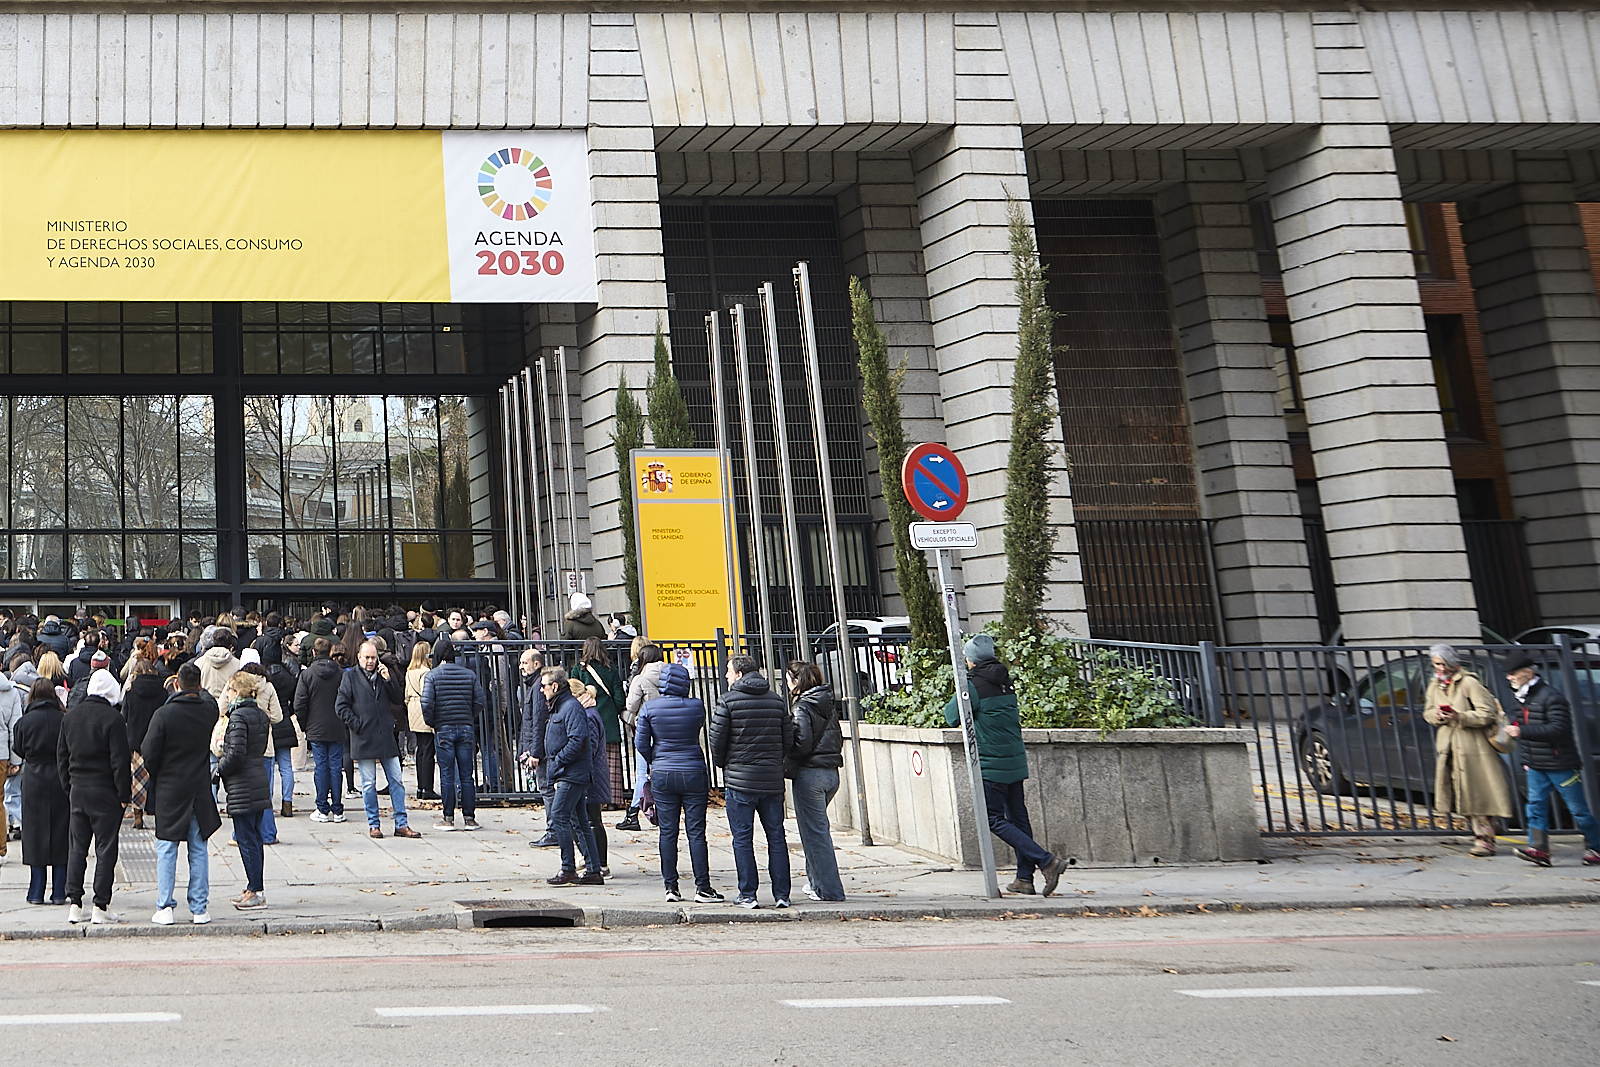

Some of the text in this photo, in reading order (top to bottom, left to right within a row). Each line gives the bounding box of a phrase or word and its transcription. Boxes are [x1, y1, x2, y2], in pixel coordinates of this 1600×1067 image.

[47, 220, 128, 232] MINISTERIO
[47, 238, 303, 252] DE DERECHOS SOCIALES, CONSUMO
[474, 231, 564, 246] AGENDA
[46, 256, 156, 269] Y AGENDA 2030
[475, 250, 565, 276] 2030
[690, 477, 712, 485] ESPAÑA
